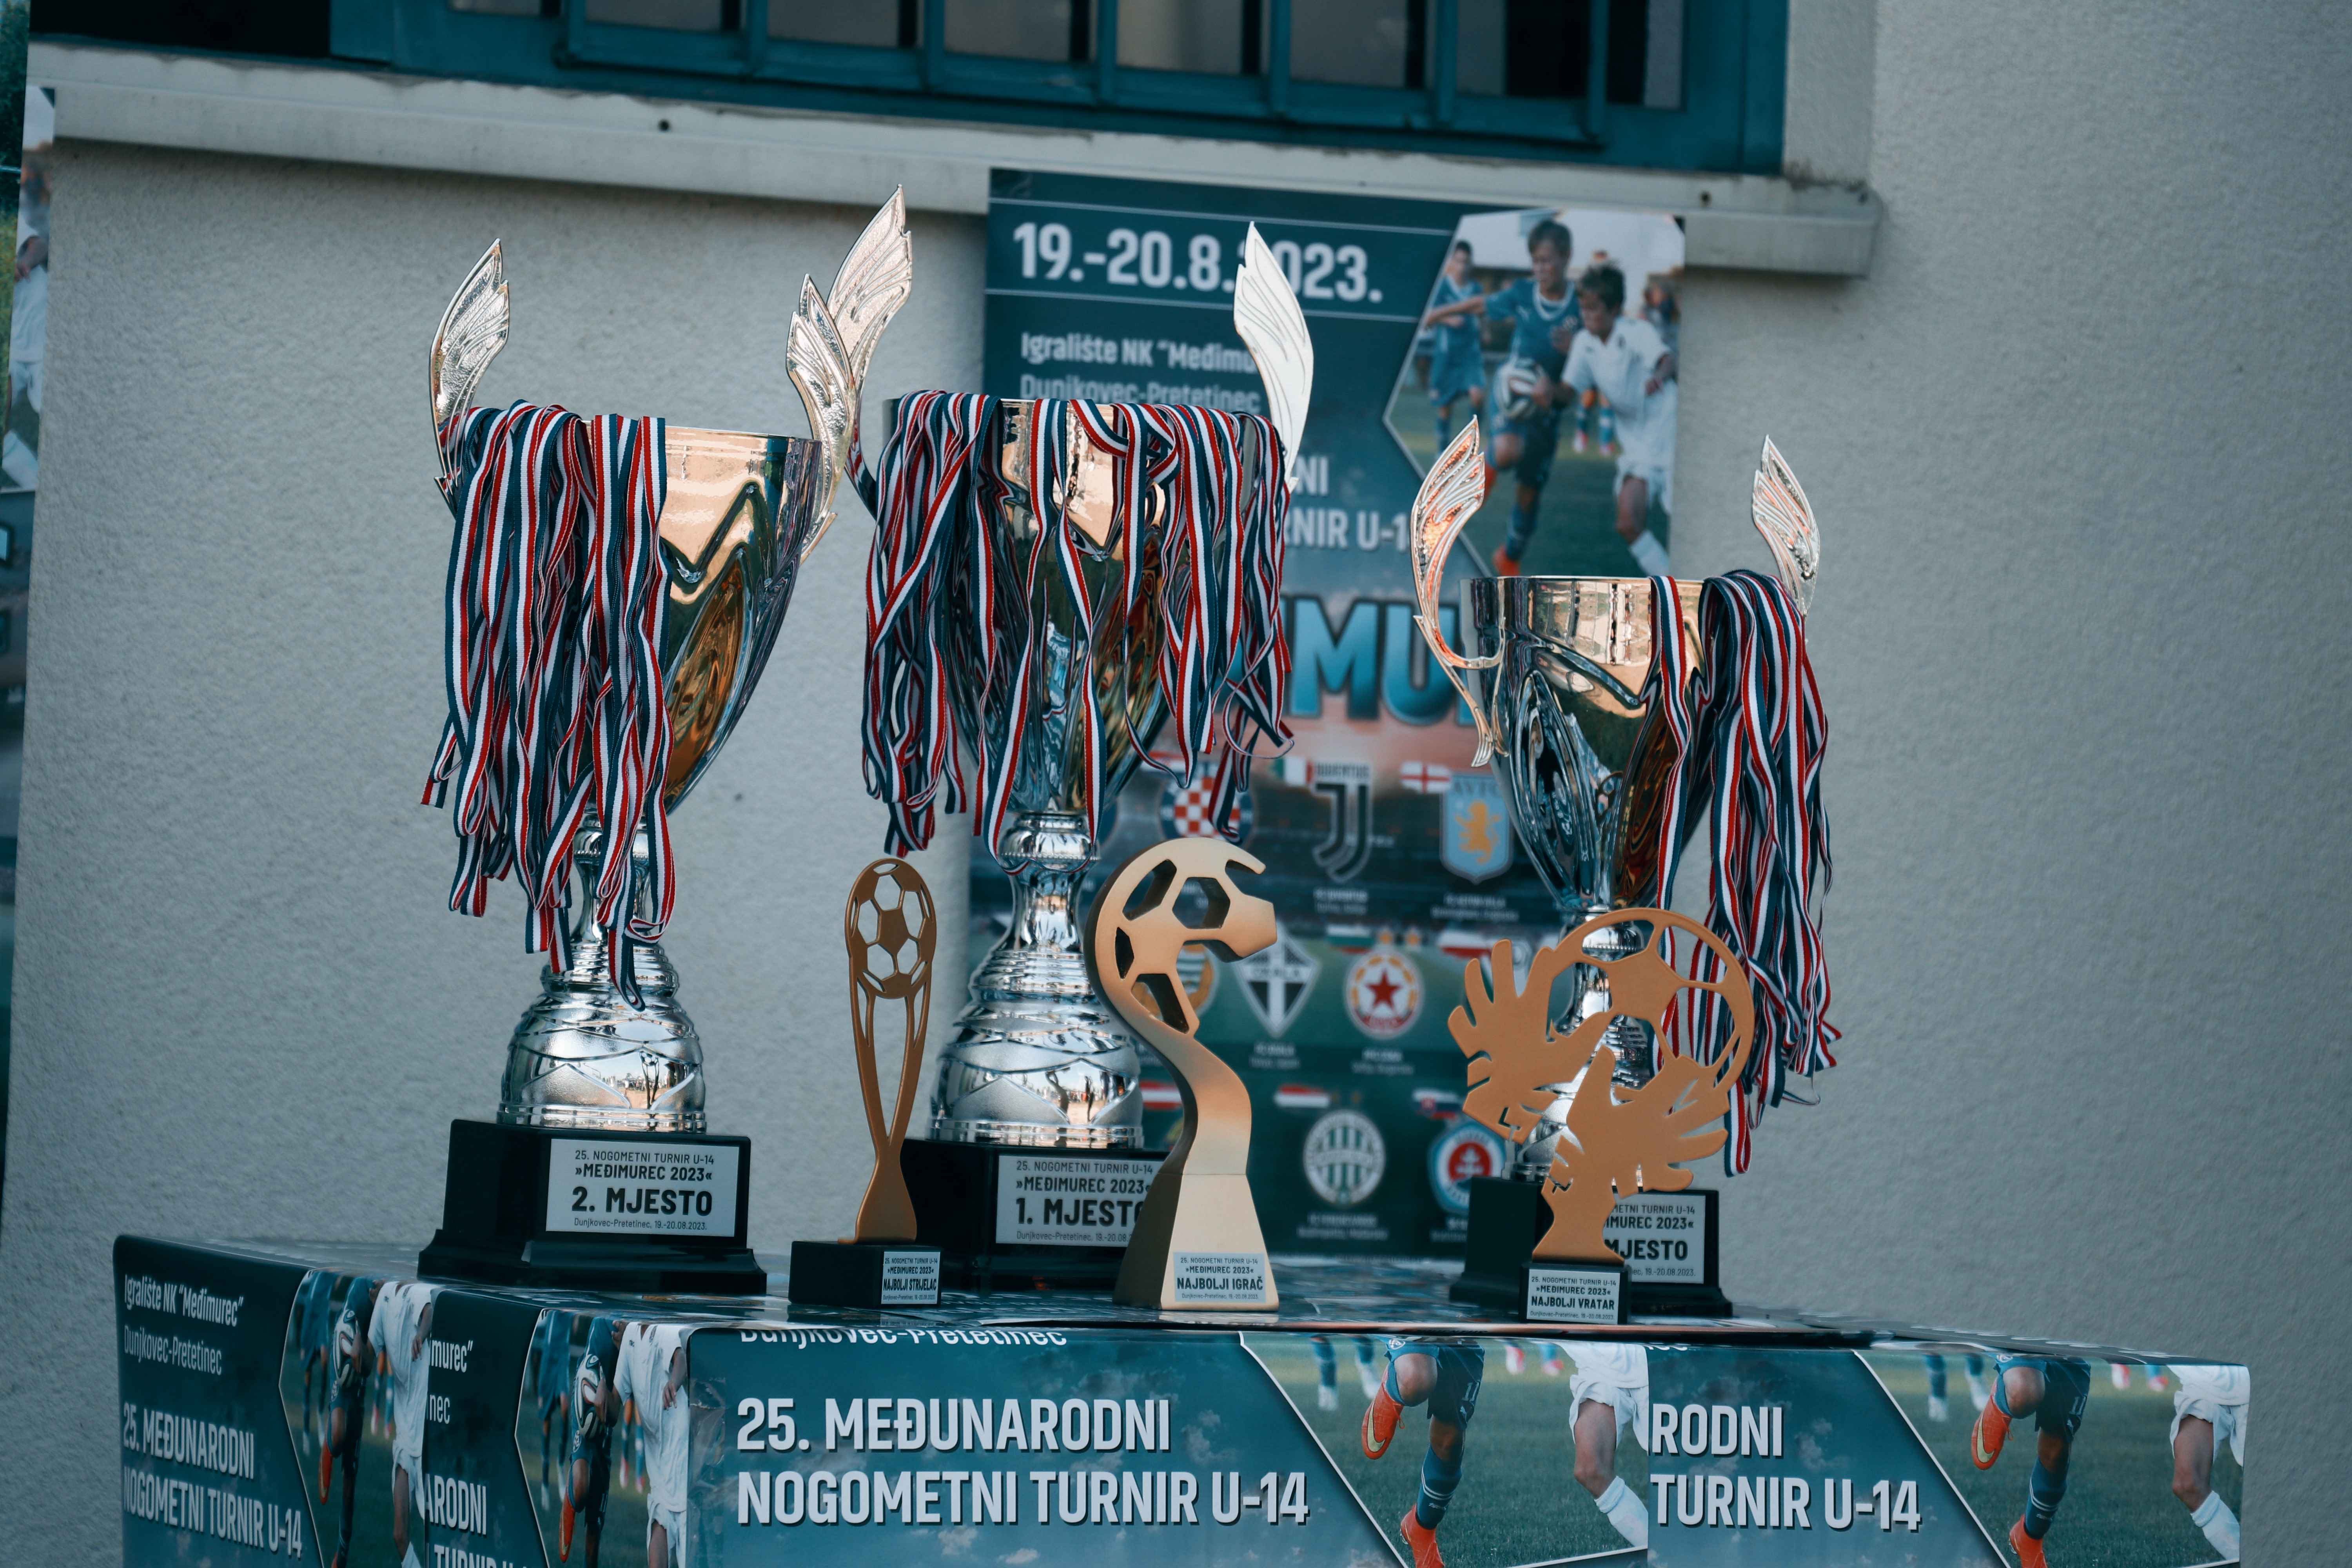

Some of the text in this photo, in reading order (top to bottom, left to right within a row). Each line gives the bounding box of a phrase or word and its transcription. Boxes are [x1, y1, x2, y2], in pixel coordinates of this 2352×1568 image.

[1013, 222, 1383, 303] 19.-20.8.023.
[1022, 332, 1117, 365] Igralište
[1122, 339, 1153, 367] NK
[1356, 511, 1408, 552] U-1
[575, 1150, 714, 1165] 25. NOGOMETNI TURNIR U-14
[1016, 1161, 1153, 1175] 25. NOGOMETNI TURNIR U-14
[575, 1163, 712, 1181] »MEĐIMUREC 2023«
[1016, 1176, 1105, 1193] »MEĐIMUREC
[572, 1186, 712, 1216] 2. MJESTO
[1016, 1198, 1033, 1225] 1.
[1612, 1205, 1695, 1214] METNI TURNIR U-14
[574, 1218, 707, 1230] Dunjkovec-Pretetinec, 19.-20.08.2023.
[1017, 1231, 1093, 1242] Dunjkovec-Pretetinec,
[1606, 1216, 1694, 1230] IMUREC 2023«
[125, 1274, 162, 1310] Igralište
[163, 1283, 178, 1314] NK
[883, 1278, 937, 1291] NAJBOLJI STRIJELAC
[1177, 1276, 1263, 1290] NAJBOLJI IGRAČ
[1531, 1296, 1615, 1310] NAJBOLJI VRATAR
[124, 1325, 222, 1376] Dunjkovec-Pretetinec
[737, 1397, 1169, 1450] 25. MEĐUNARODNI
[1652, 1403, 1782, 1456] RODNI
[123, 1402, 254, 1480] 25. MEĐUNARODNI
[738, 1471, 1308, 1524] NOGOMETNI TURNIR U-14
[1650, 1474, 1921, 1530] TURNIR U-14
[123, 1466, 302, 1559] NOGOMETNI TURNIR U-14
